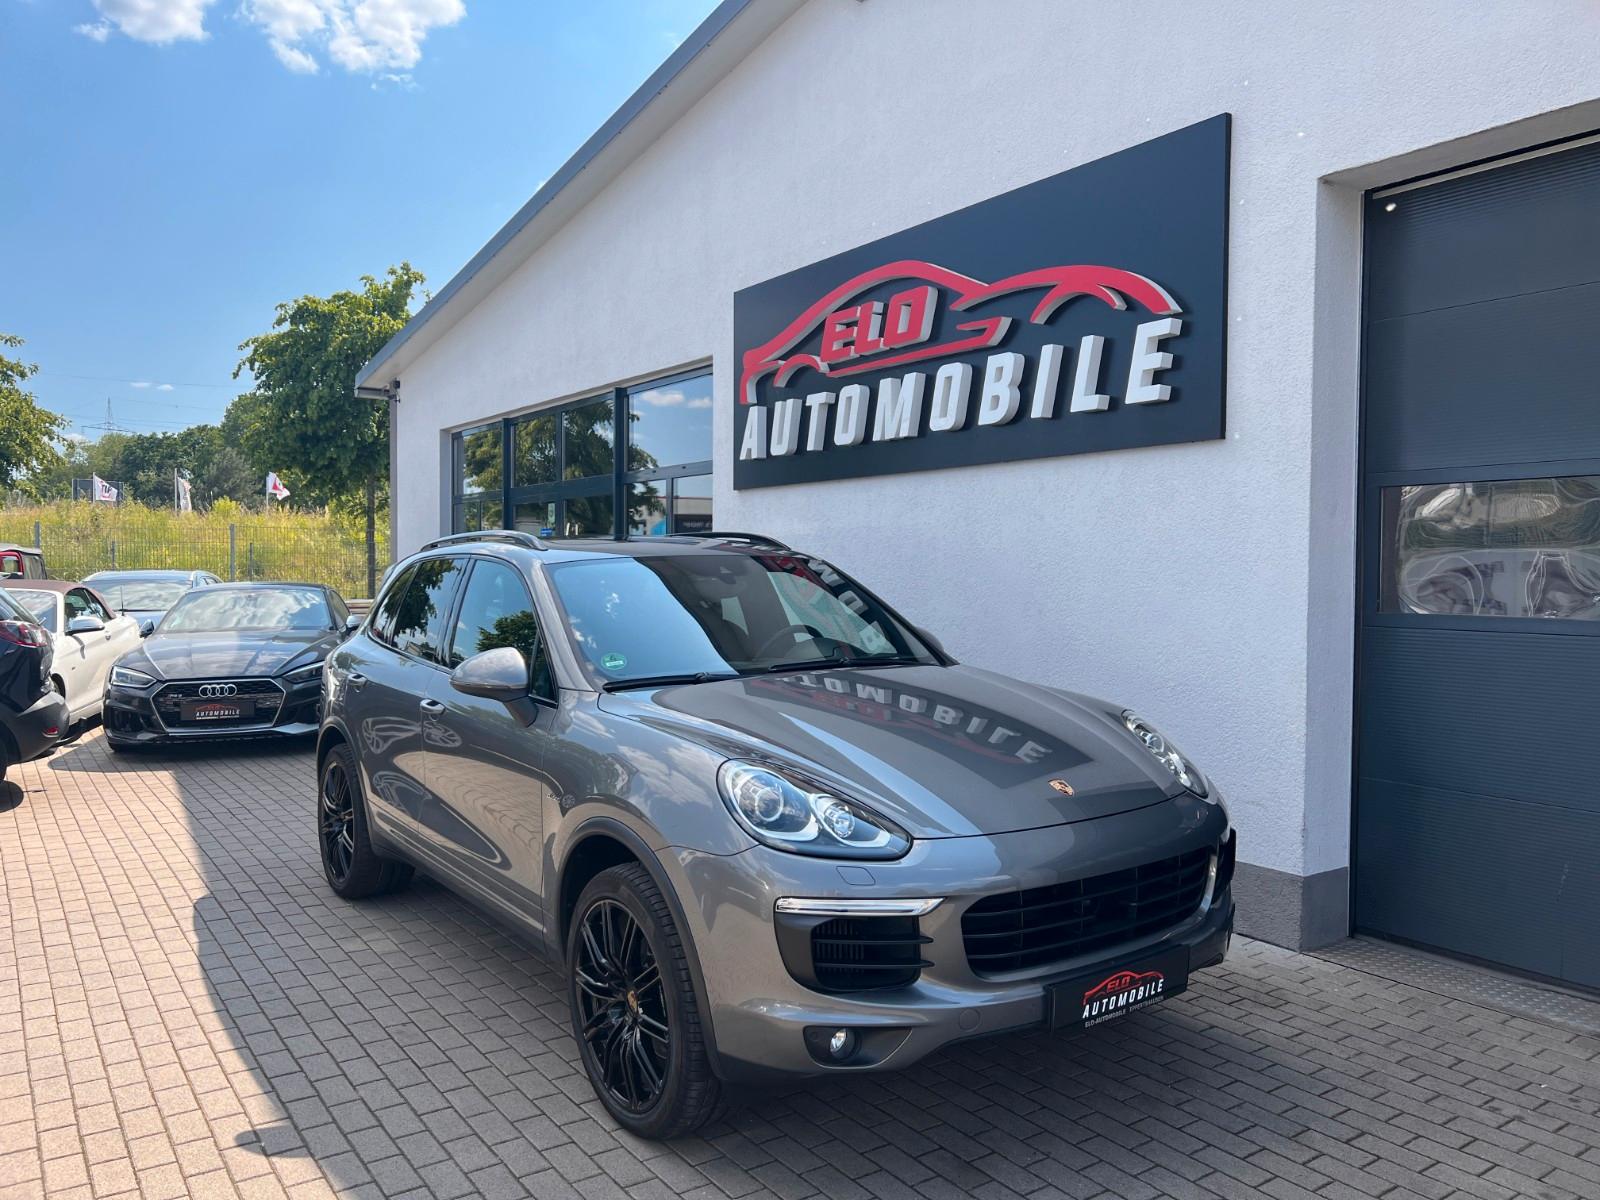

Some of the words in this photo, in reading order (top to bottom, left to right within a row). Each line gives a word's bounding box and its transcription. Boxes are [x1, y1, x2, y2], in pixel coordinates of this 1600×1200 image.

[819, 286, 938, 363] ELO
[739, 317, 1182, 461] AUTOMOBILE
[196, 709, 240, 717] AUTOMOBILE
[1082, 978, 1164, 1019] AUTOMOBILE
[1106, 975, 1131, 993] ELO
